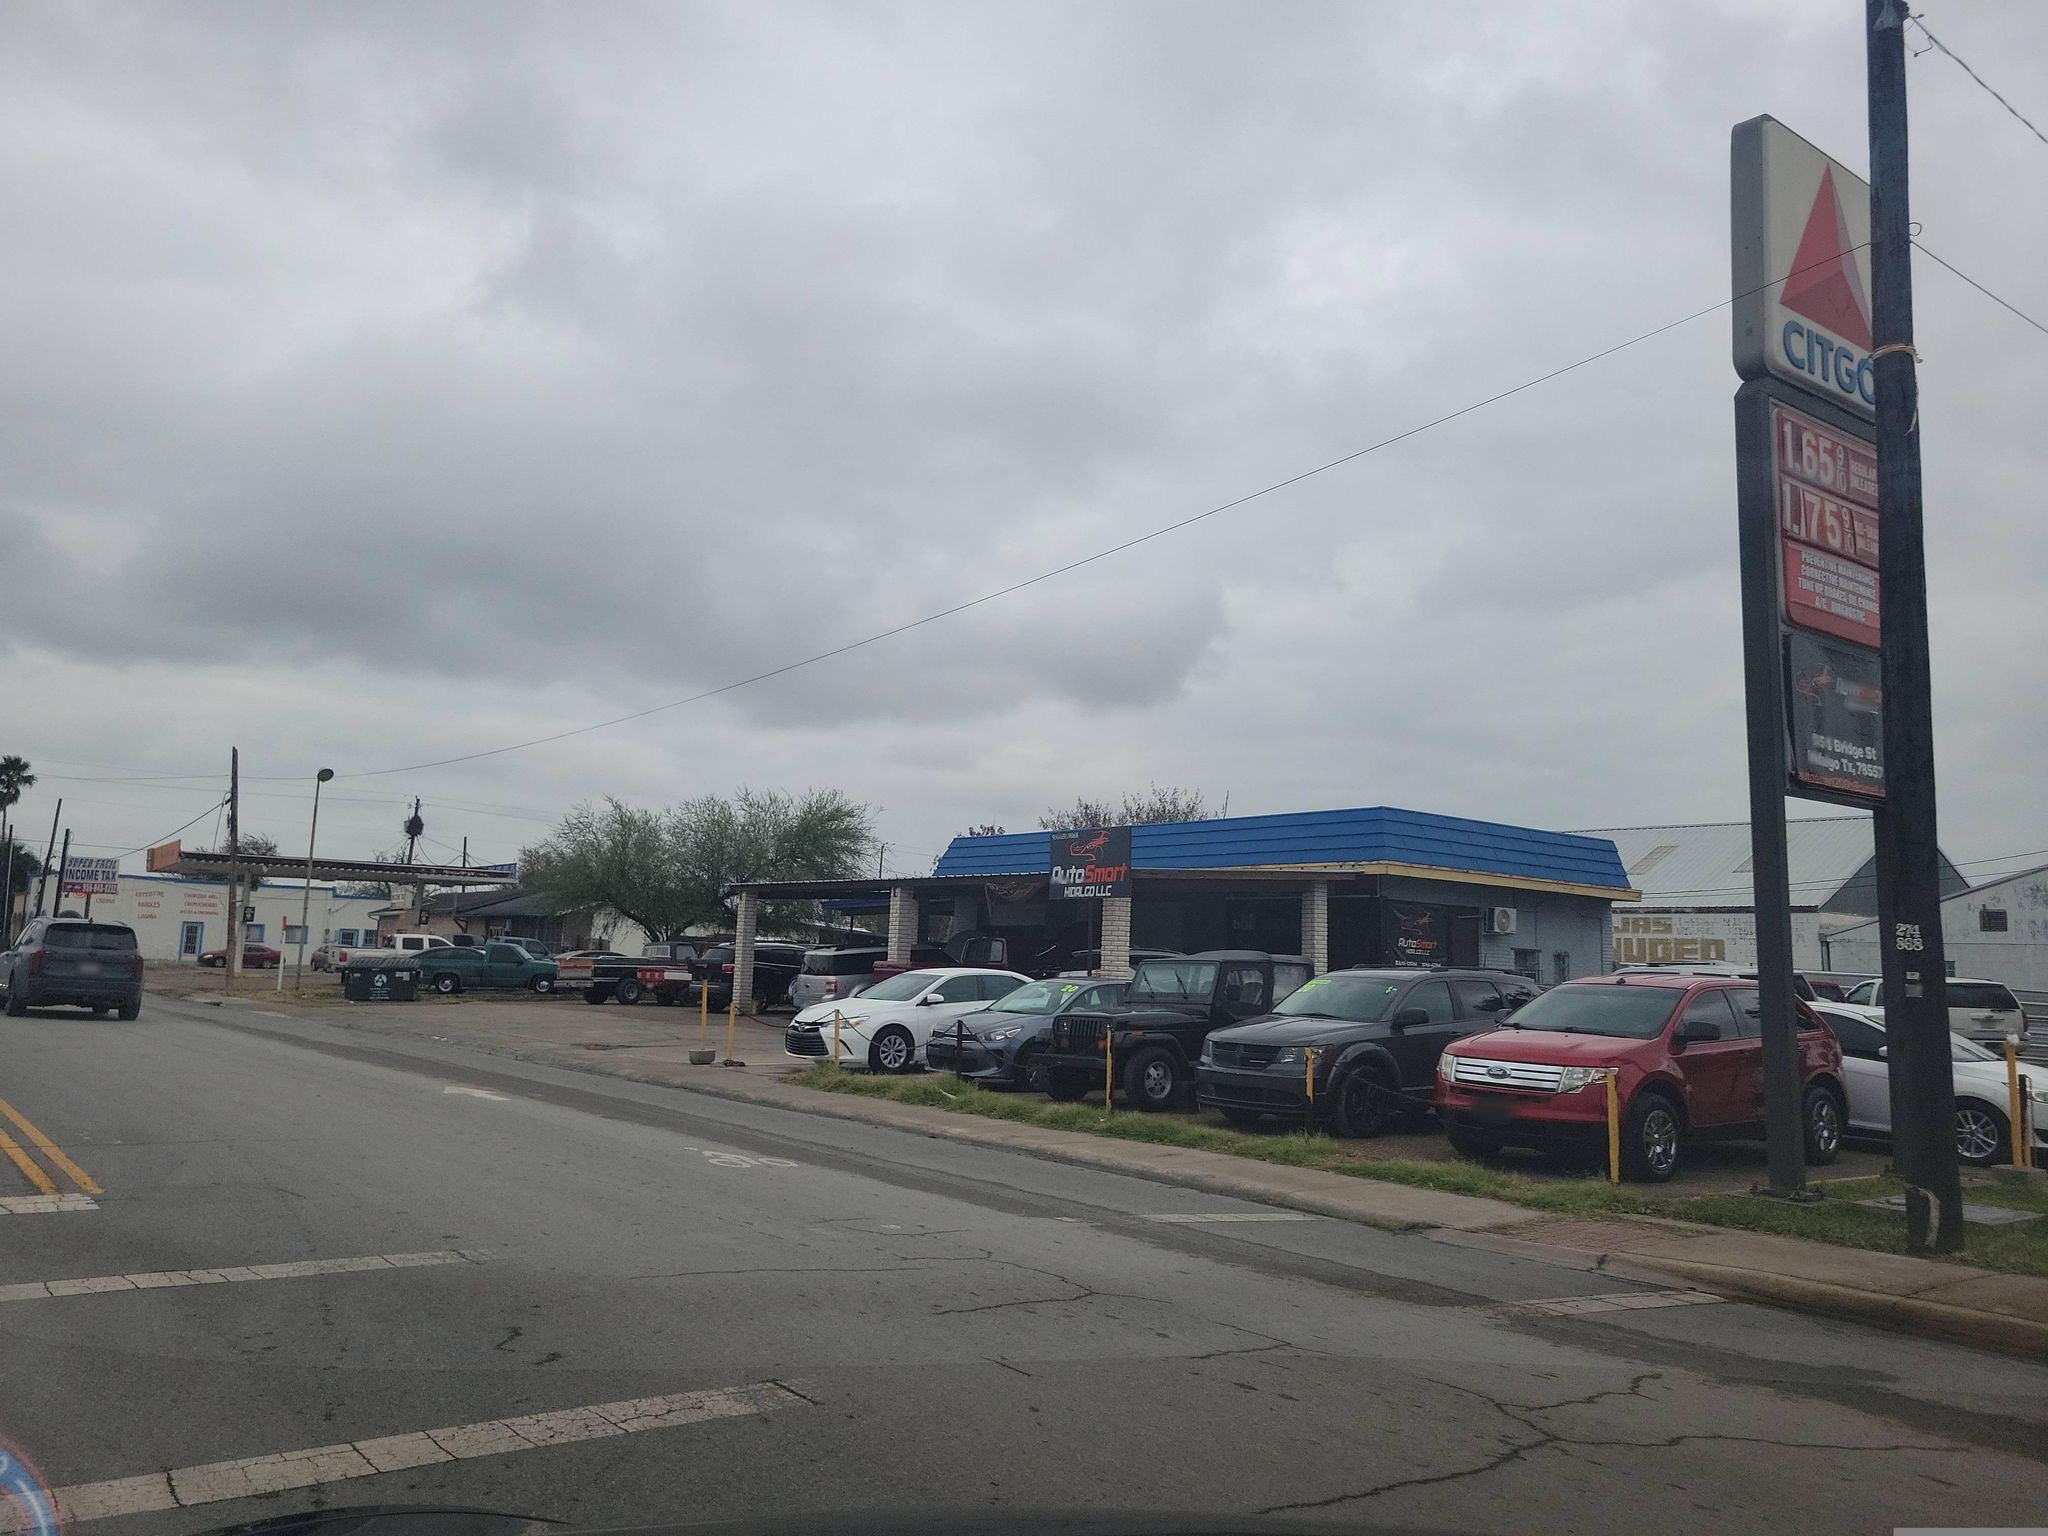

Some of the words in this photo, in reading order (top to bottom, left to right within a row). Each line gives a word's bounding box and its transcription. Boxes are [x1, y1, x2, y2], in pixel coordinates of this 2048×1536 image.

[1783, 320, 1876, 405] CITGO
[1783, 421, 1835, 485] 1.65
[1834, 739, 1864, 759] Bridge
[1865, 746, 1877, 761] St
[65, 869, 99, 880] INCOME
[102, 870, 117, 881] TAX
[1096, 885, 1112, 897] LLC
[1895, 922, 1921, 938] 274
